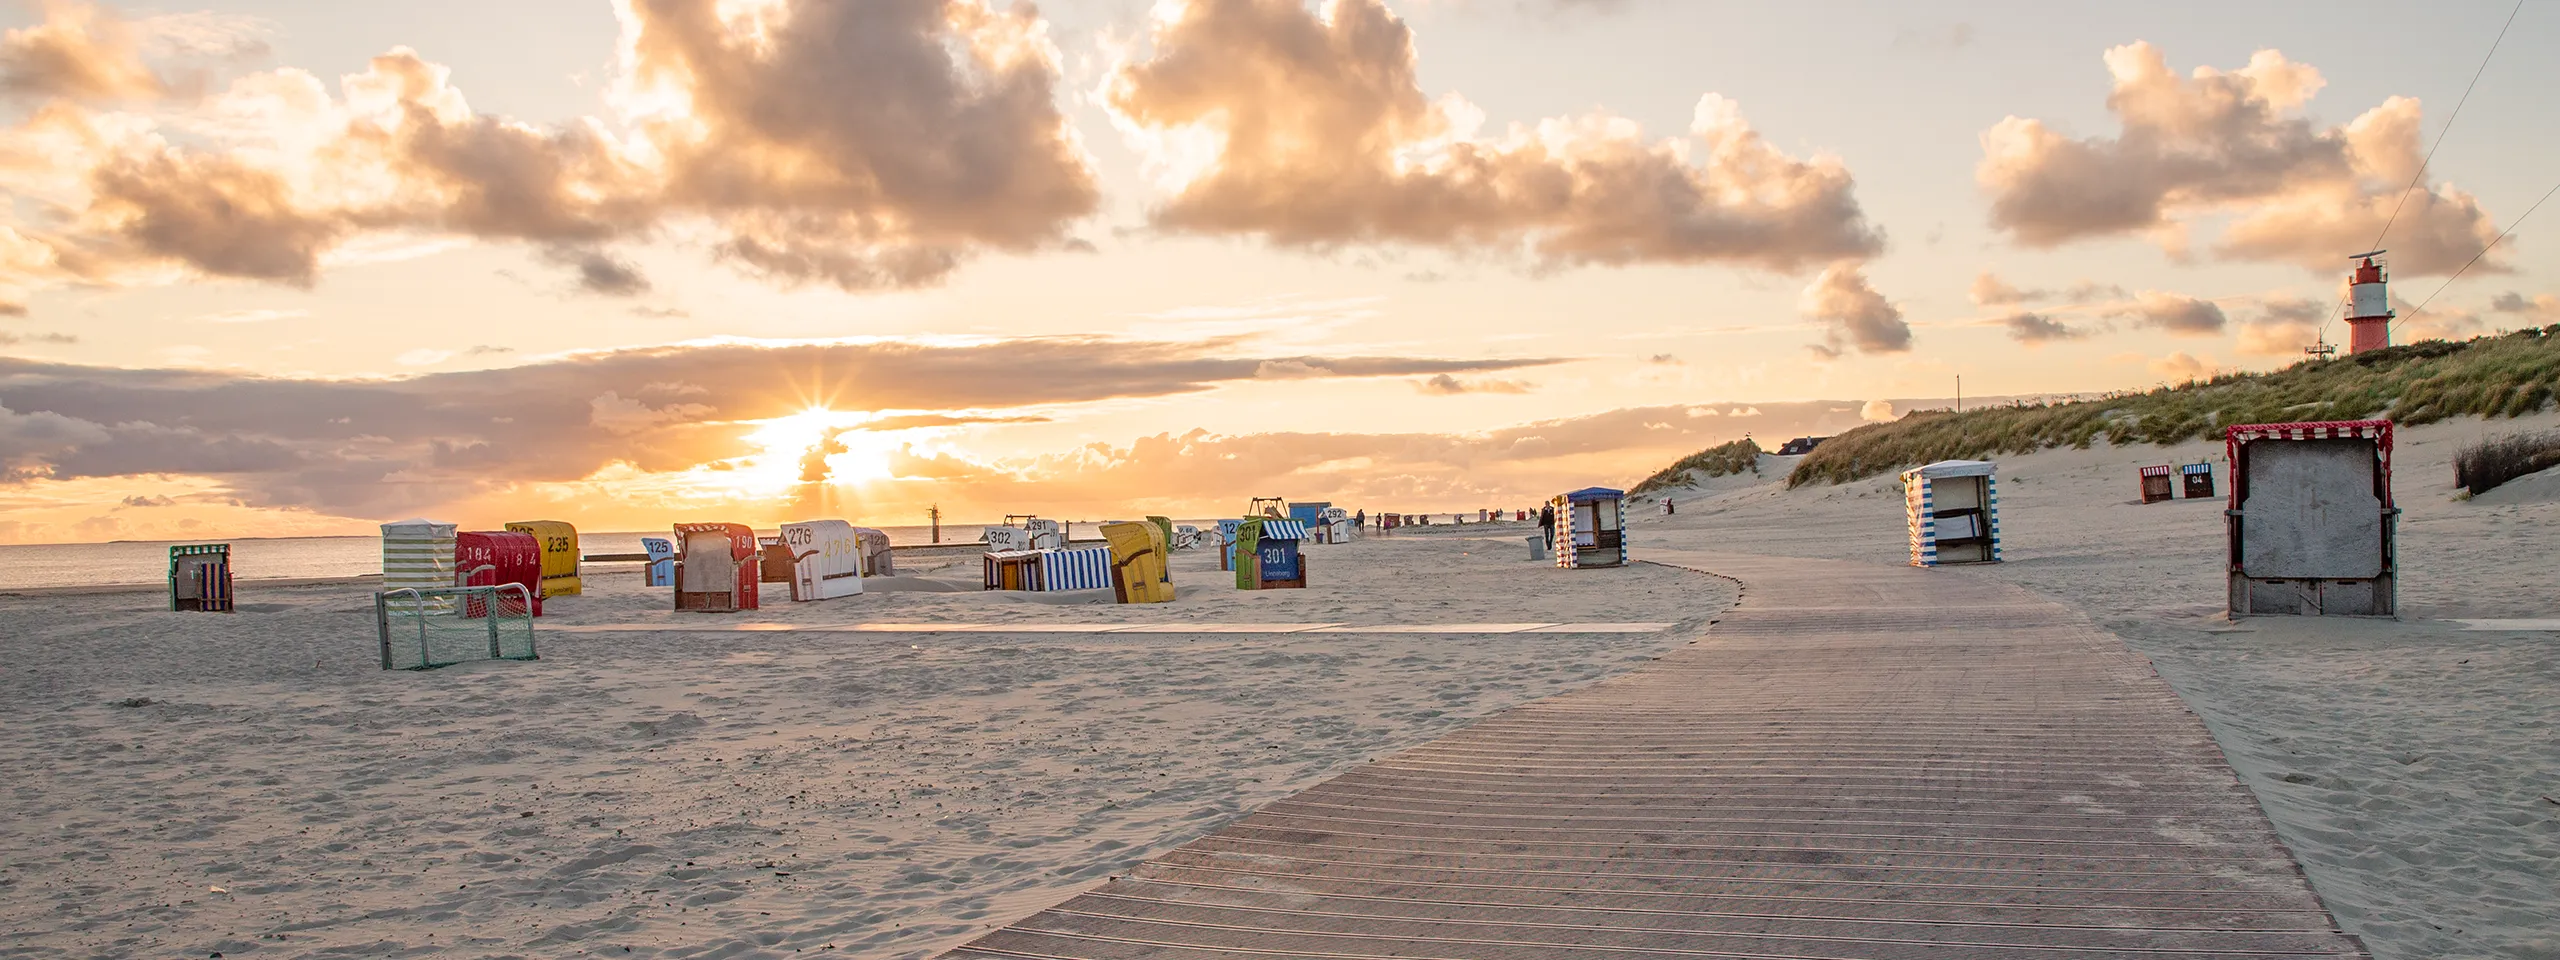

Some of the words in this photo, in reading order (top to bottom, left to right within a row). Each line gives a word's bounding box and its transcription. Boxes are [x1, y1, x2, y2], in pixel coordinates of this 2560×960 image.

[1328, 510, 1342, 518] 292
[1032, 521, 1046, 530] 291
[789, 528, 812, 545] 276
[991, 531, 1011, 544] 302
[1240, 525, 1256, 542] 301
[548, 537, 569, 552] 235
[649, 542, 668, 553] 125
[736, 536, 753, 549] 190
[824, 538, 851, 558] 276
[467, 547, 491, 561] 184
[1264, 548, 1286, 564] 301
